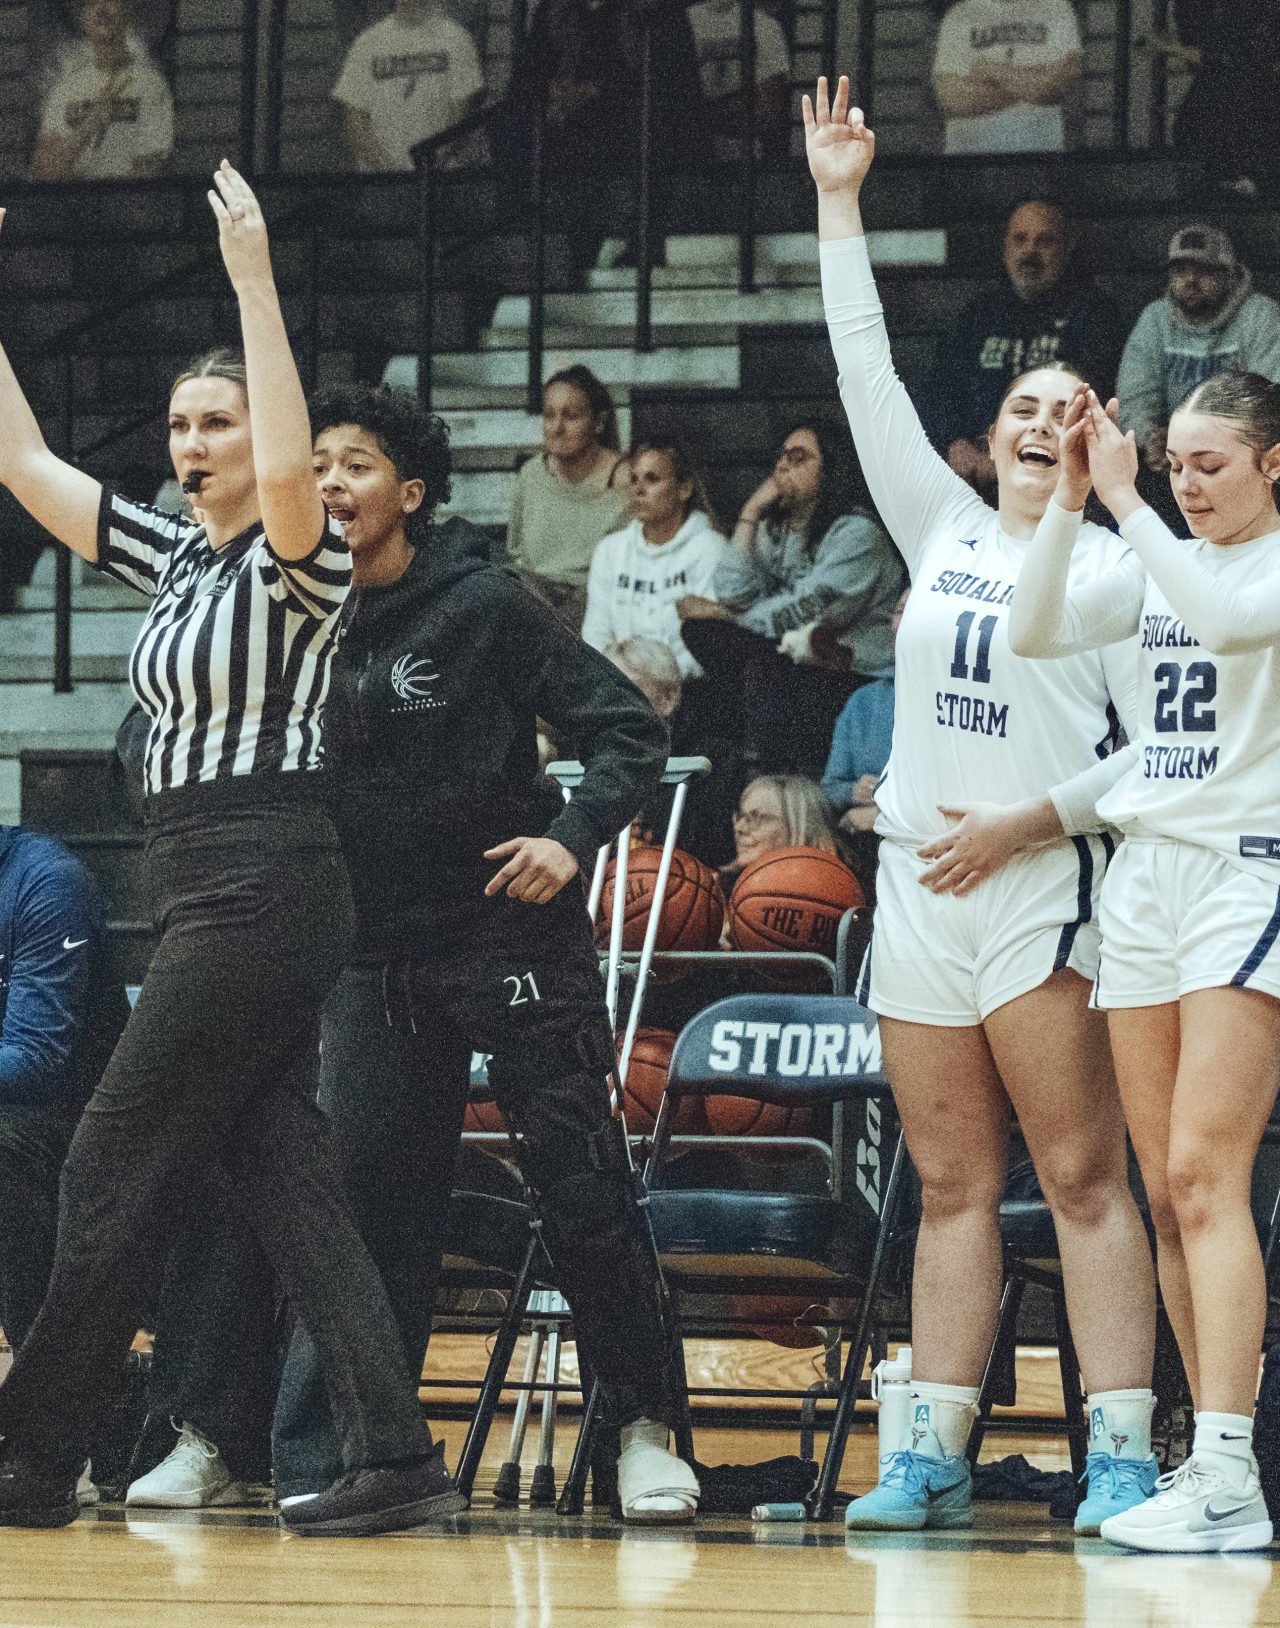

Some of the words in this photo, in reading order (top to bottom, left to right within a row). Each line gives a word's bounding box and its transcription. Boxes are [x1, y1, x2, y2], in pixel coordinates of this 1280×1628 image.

[950, 611, 998, 684] 11
[936, 691, 1009, 738] STORM
[1154, 661, 1217, 733] 22
[1143, 745, 1219, 780] STORM
[763, 906, 804, 939] THE
[503, 971, 540, 1006] 21
[708, 1020, 882, 1077] STORM
